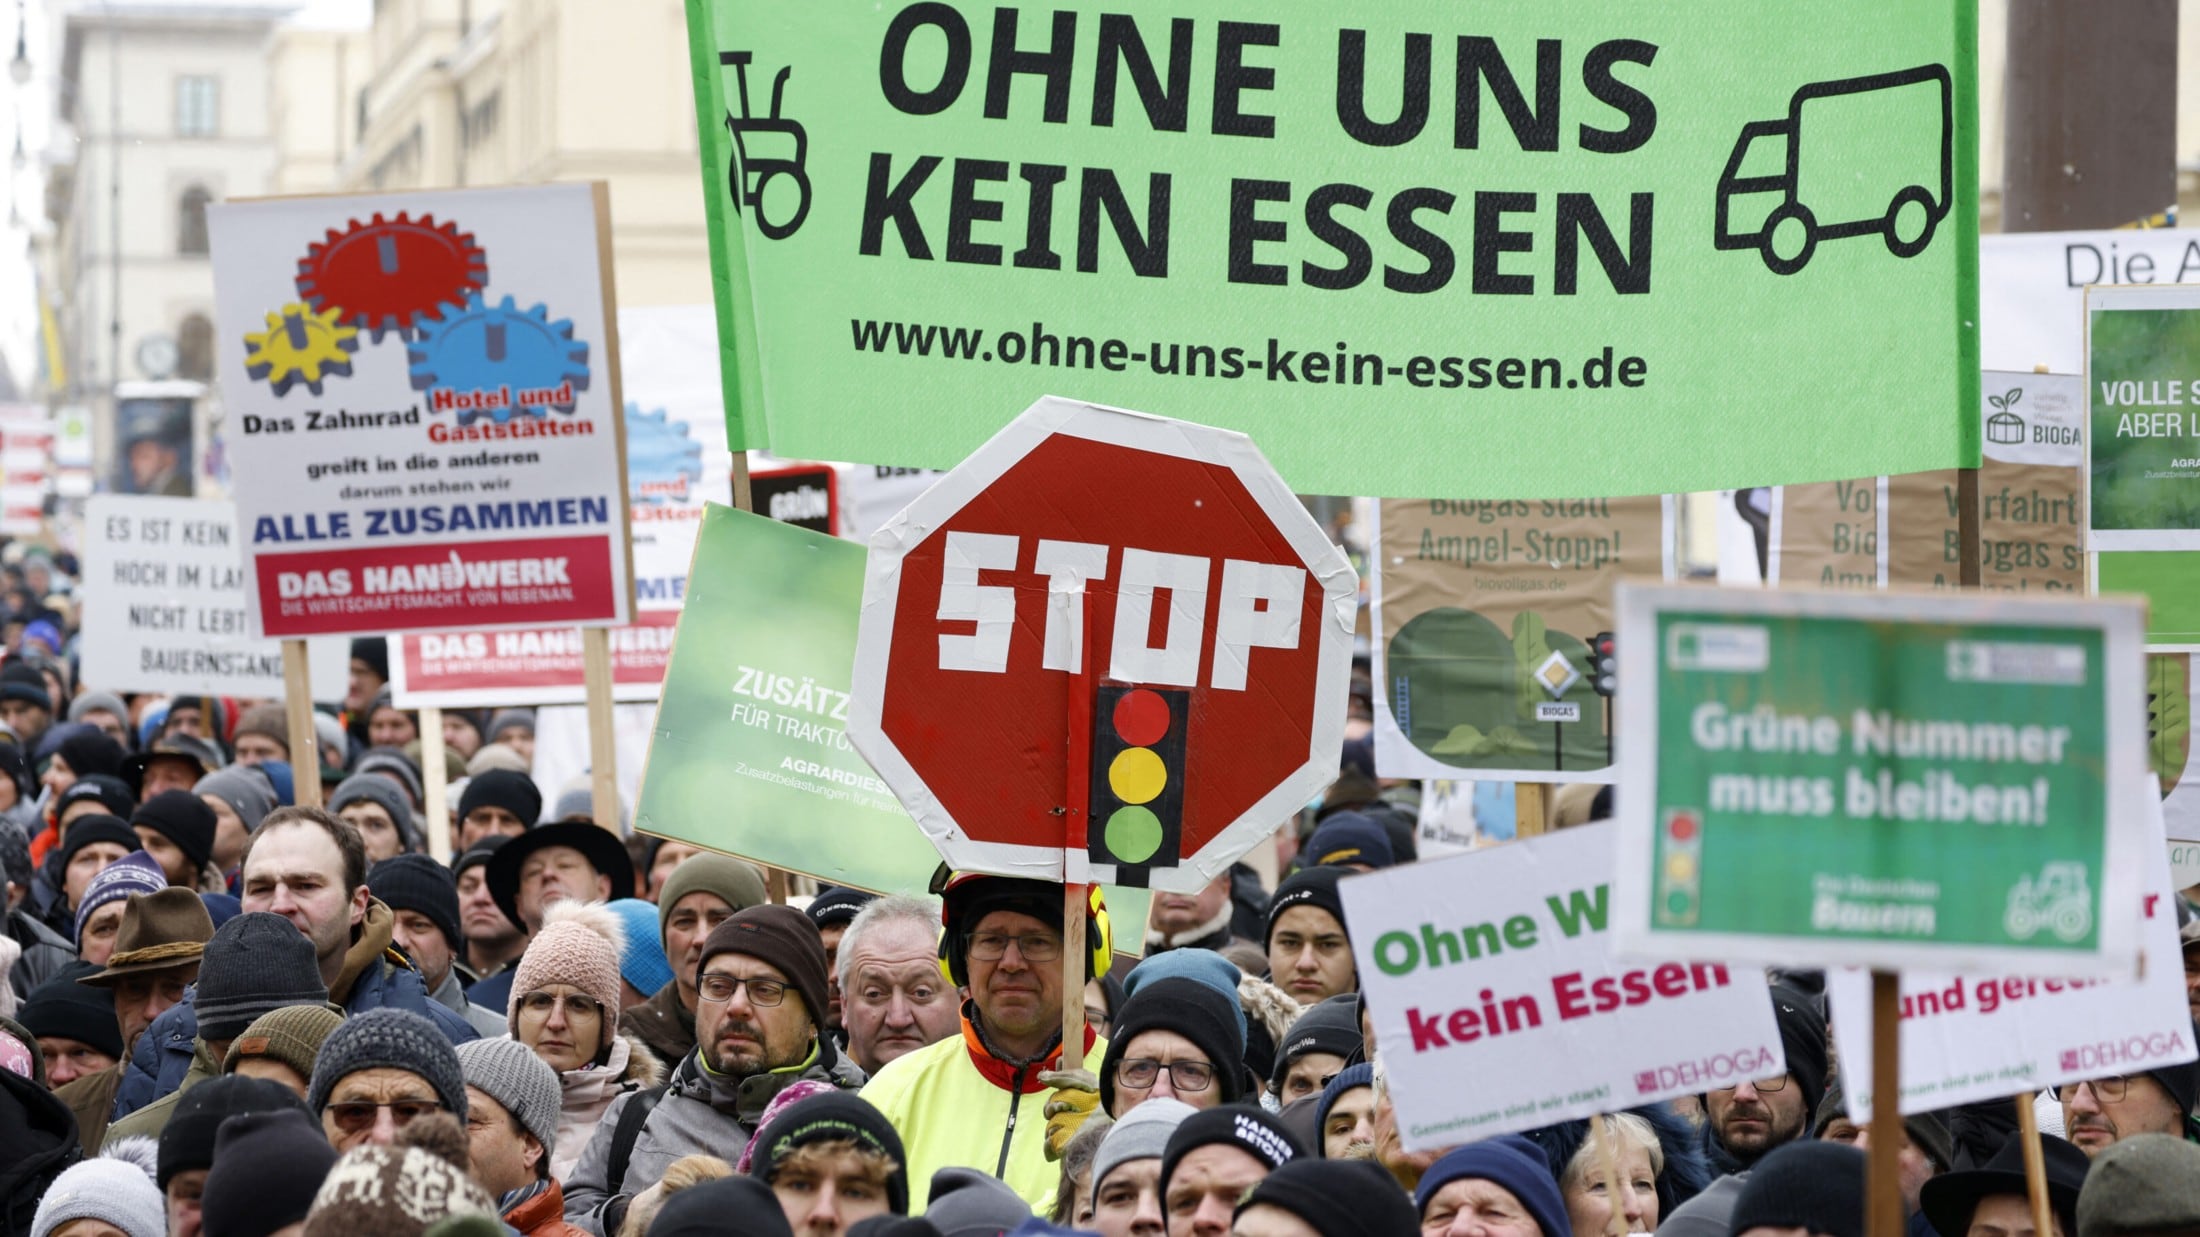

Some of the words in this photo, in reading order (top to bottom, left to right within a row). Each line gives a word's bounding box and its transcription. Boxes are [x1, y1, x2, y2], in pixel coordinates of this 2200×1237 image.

[879, 1, 1280, 138] OHNE
[1336, 28, 1659, 154] UNS
[859, 152, 1172, 278] KEIN
[1227, 177, 1654, 295] ESSEN
[2066, 240, 2154, 288] Die
[851, 318, 1648, 389] www.ohne-uns-kein-essen.de
[432, 387, 508, 411] Hotel
[520, 383, 573, 405] und
[2101, 380, 2182, 406] VOLLE
[243, 414, 294, 435] Das
[306, 406, 420, 431] Zahnrad
[428, 418, 594, 444] Gaststätten
[2116, 412, 2182, 437] ABER
[307, 457, 368, 479] greift
[377, 455, 397, 473] in
[405, 453, 439, 472] die
[449, 450, 540, 469] anderen
[339, 485, 402, 501] darum
[409, 479, 474, 496] stehen
[480, 477, 512, 492] wir
[1944, 485, 2077, 525] Vrfahrt
[105, 515, 130, 541] ES
[141, 517, 170, 543] IST
[183, 520, 231, 545] KEIN
[253, 512, 351, 544] ALLE
[365, 496, 609, 538] ZUSAMMEN
[1418, 528, 1621, 570] Ampel-Stopp!
[113, 561, 166, 587] HOCH
[177, 564, 199, 589] IM
[277, 569, 353, 599] DAS
[363, 553, 570, 594] HANDWERK
[128, 605, 187, 631] NICHT
[199, 609, 246, 635] LEBT
[280, 600, 305, 616] DIE
[466, 590, 498, 606] VON
[936, 531, 1307, 691] STOP
[419, 632, 488, 659] DAS
[732, 665, 851, 722] ZUSÄTZ
[1542, 706, 1575, 717] BIOGAS
[731, 703, 770, 730] FÜR
[776, 714, 855, 752] TRAKTO
[1692, 701, 1841, 756] Grüne
[1851, 708, 2071, 764] Nummer
[735, 762, 850, 801] Zusatzbelastungen
[1709, 772, 1836, 816] muss
[1845, 765, 2050, 826] bleiben!
[1372, 914, 1538, 978] Ohne
[1545, 883, 1610, 939] W
[1812, 893, 1937, 936] Bauern
[1406, 988, 1543, 1053] kein
[1550, 962, 1731, 1022] Essen
[1657, 1045, 1776, 1092] DEHOGA
[2080, 1030, 2185, 1071] DEHOGA
[1410, 1108, 1500, 1138] Gemeinsam
[1504, 1100, 1536, 1119] sind
[1540, 1096, 1563, 1111] wir
[1235, 1126, 1285, 1167] BETON
